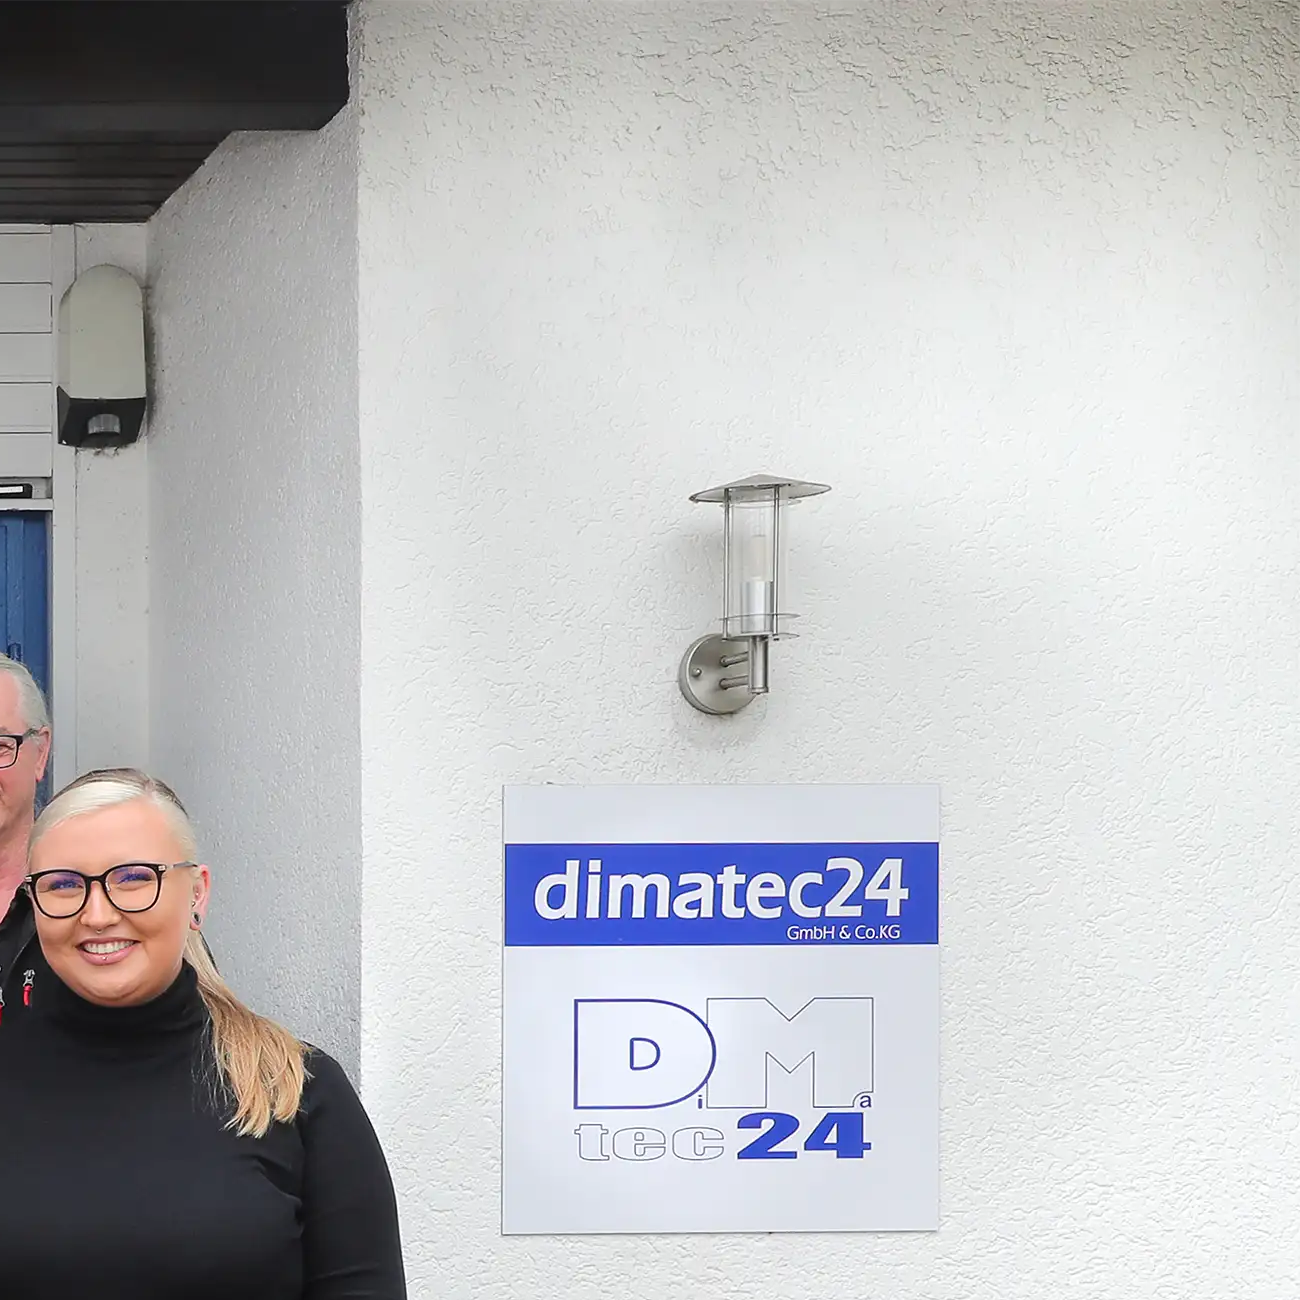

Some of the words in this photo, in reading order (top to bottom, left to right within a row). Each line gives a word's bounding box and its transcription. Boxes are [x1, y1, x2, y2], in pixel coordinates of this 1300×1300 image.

[534, 857, 910, 920] dimatec24
[787, 924, 835, 940] GmbH
[839, 925, 852, 940] &
[855, 924, 901, 940] Co.KG
